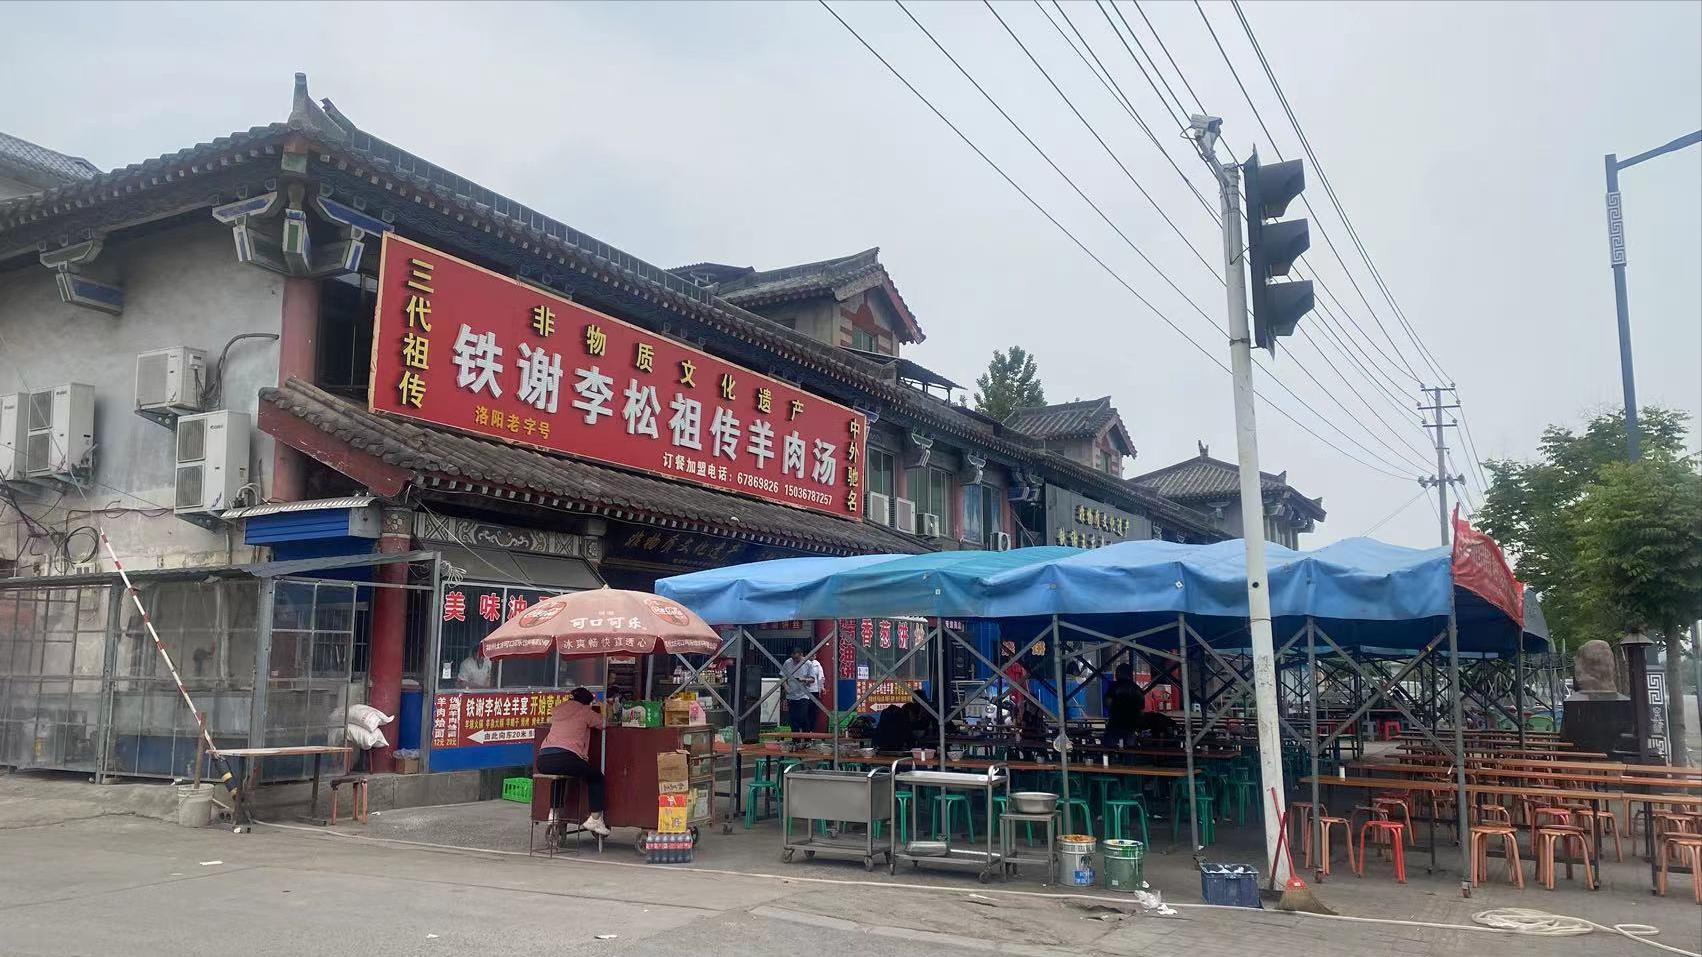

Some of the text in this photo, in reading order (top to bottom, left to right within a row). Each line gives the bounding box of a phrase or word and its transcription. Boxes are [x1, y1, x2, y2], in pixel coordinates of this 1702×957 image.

[400, 258, 434, 408] 三代祖传
[532, 306, 802, 421] 非物质文化遗产
[453, 324, 836, 486] 铁谢李松祖传羊肉汤
[475, 406, 551, 440] 洛阳老字号
[846, 418, 861, 512] 中外驰名
[737, 472, 779, 494] 67869826
[784, 484, 832, 506] 15036787257
[443, 591, 550, 622] 美味油
[569, 616, 643, 630] 可口可乐
[563, 637, 647, 650] 冰爽畅快直透心
[434, 697, 447, 738] 羊肉烩面
[466, 696, 529, 717] 铁谢李松全羊宴
[484, 730, 527, 741] 由此向东20米
